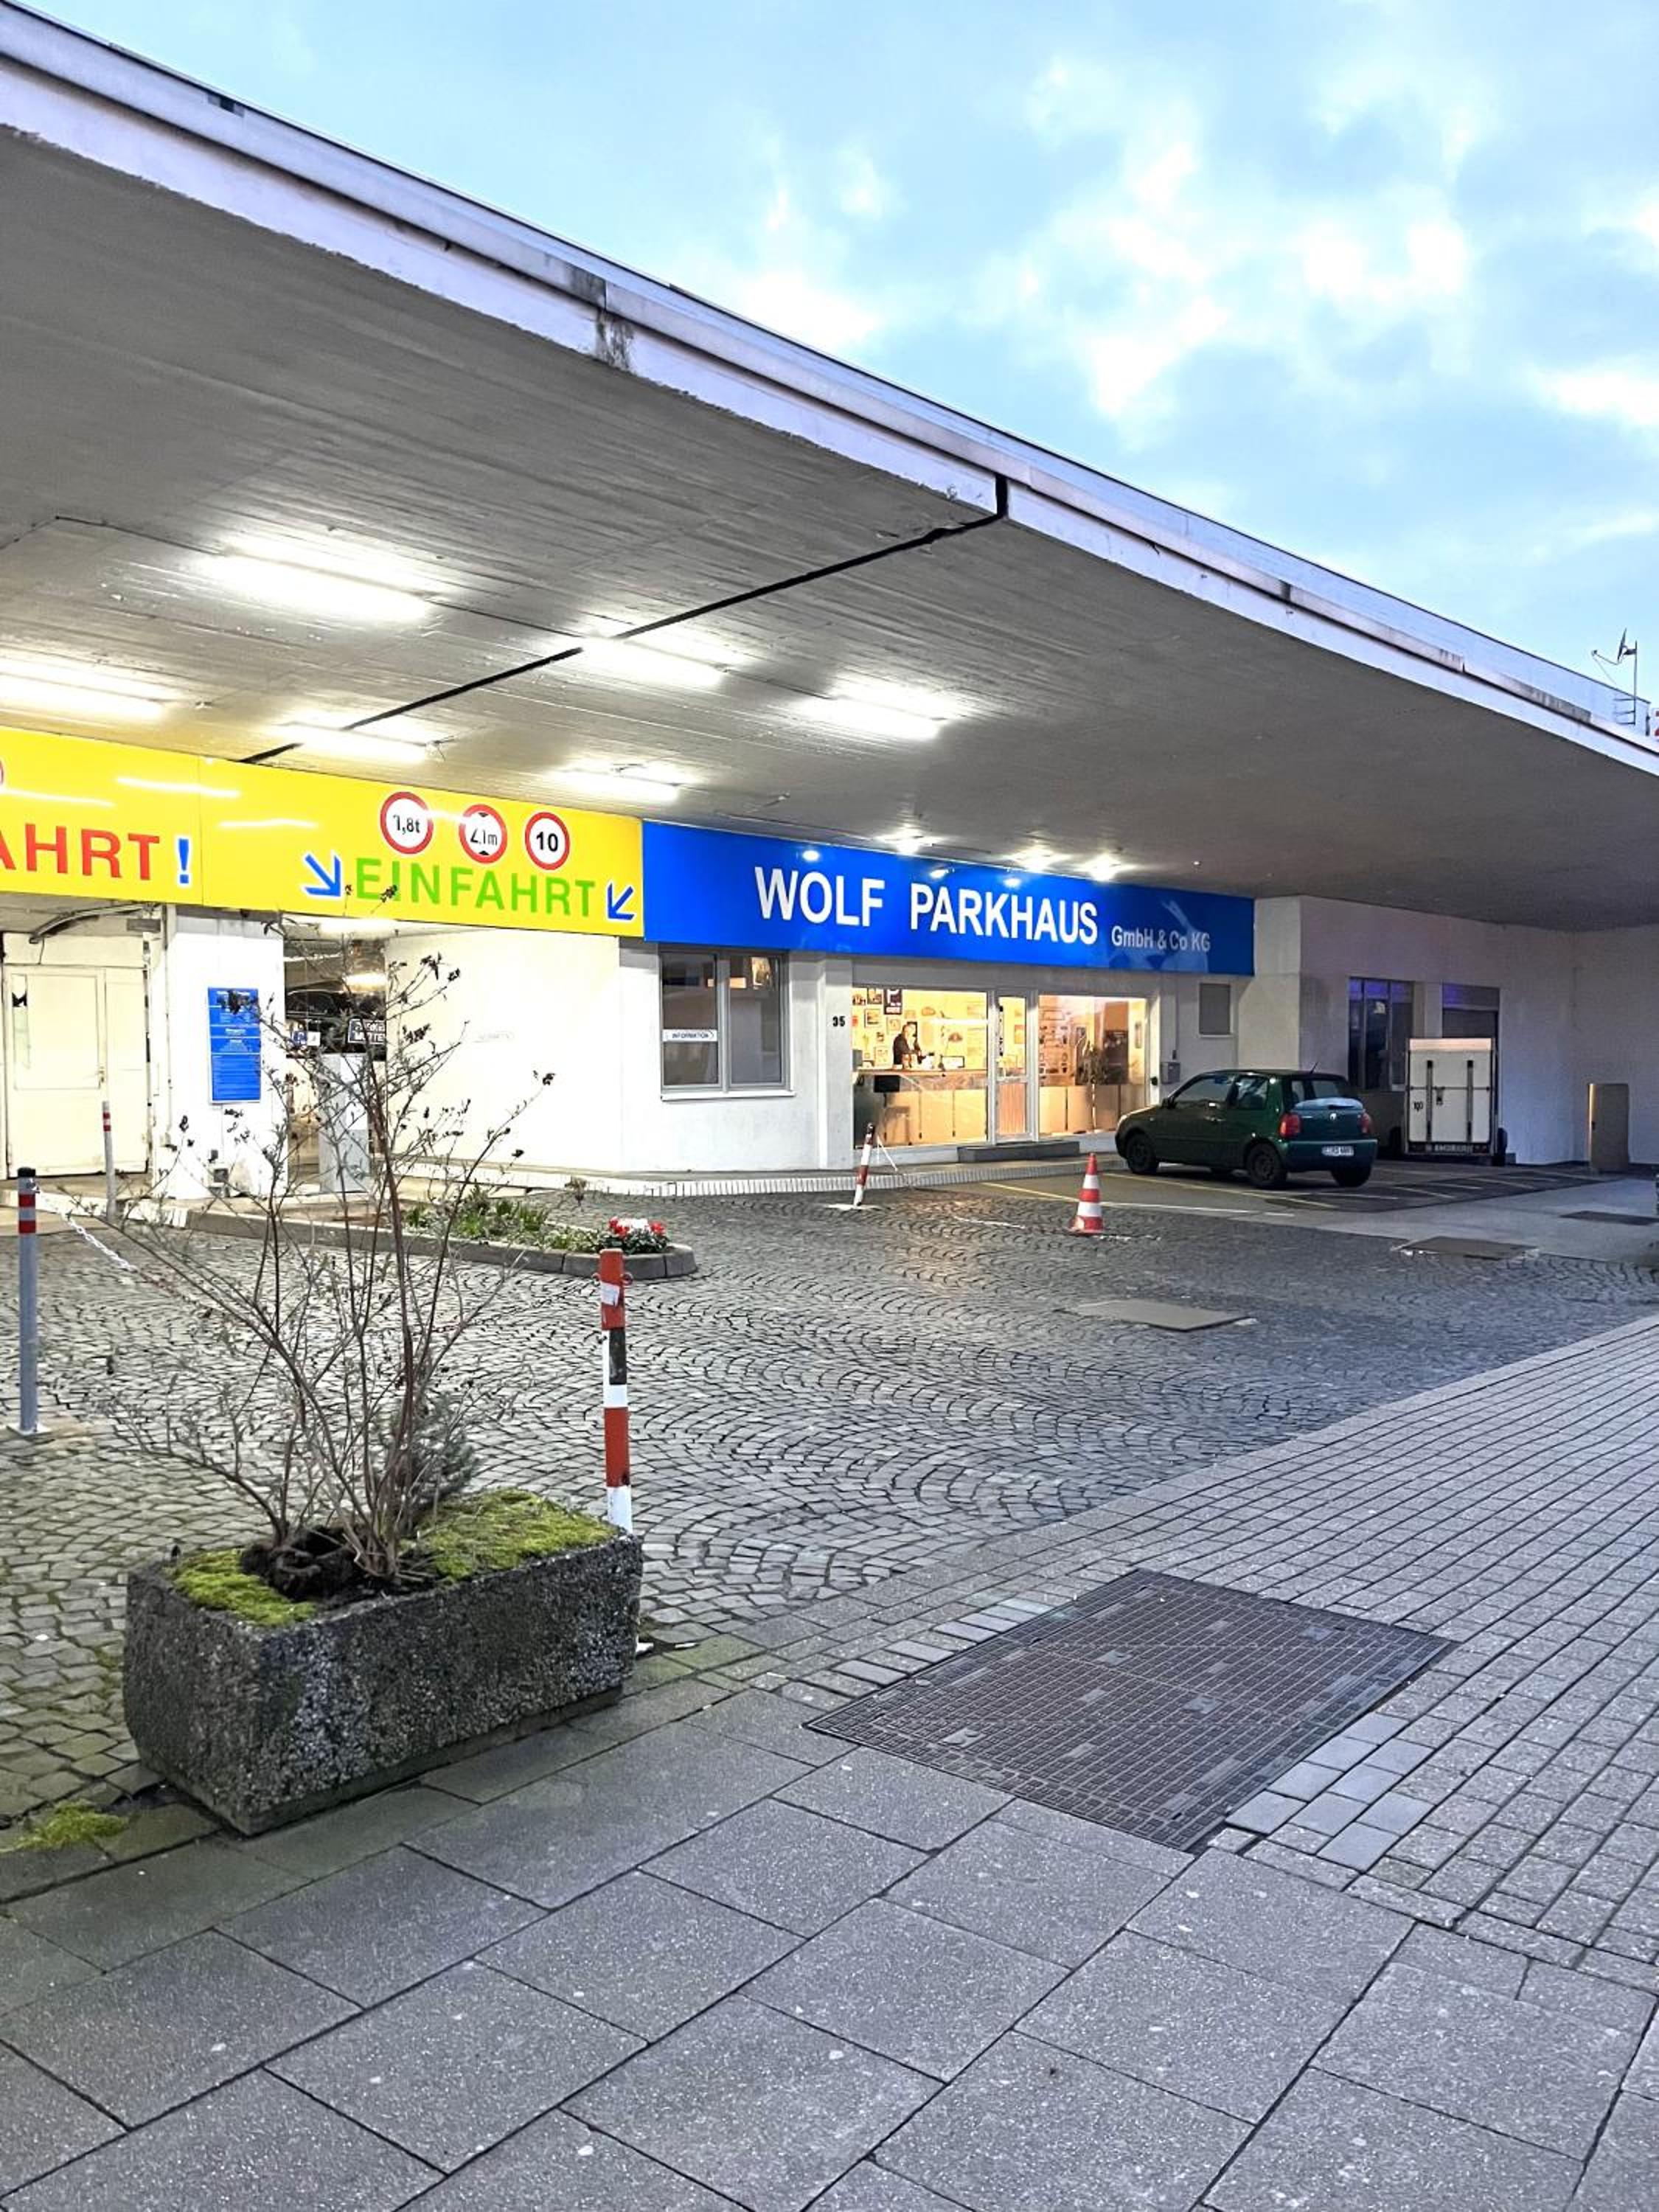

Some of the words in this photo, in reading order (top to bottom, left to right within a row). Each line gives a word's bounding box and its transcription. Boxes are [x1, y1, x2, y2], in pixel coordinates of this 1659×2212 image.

[536, 831, 559, 852] 10
[354, 856, 596, 920] EINFAHRT
[754, 866, 885, 927] WOLF
[911, 883, 1098, 945] PARKHAUS
[1111, 925, 1154, 949] GmbH
[1157, 929, 1167, 950] &
[1169, 930, 1188, 951] Co
[1192, 932, 1211, 952] KG
[832, 1016, 846, 1027] 35
